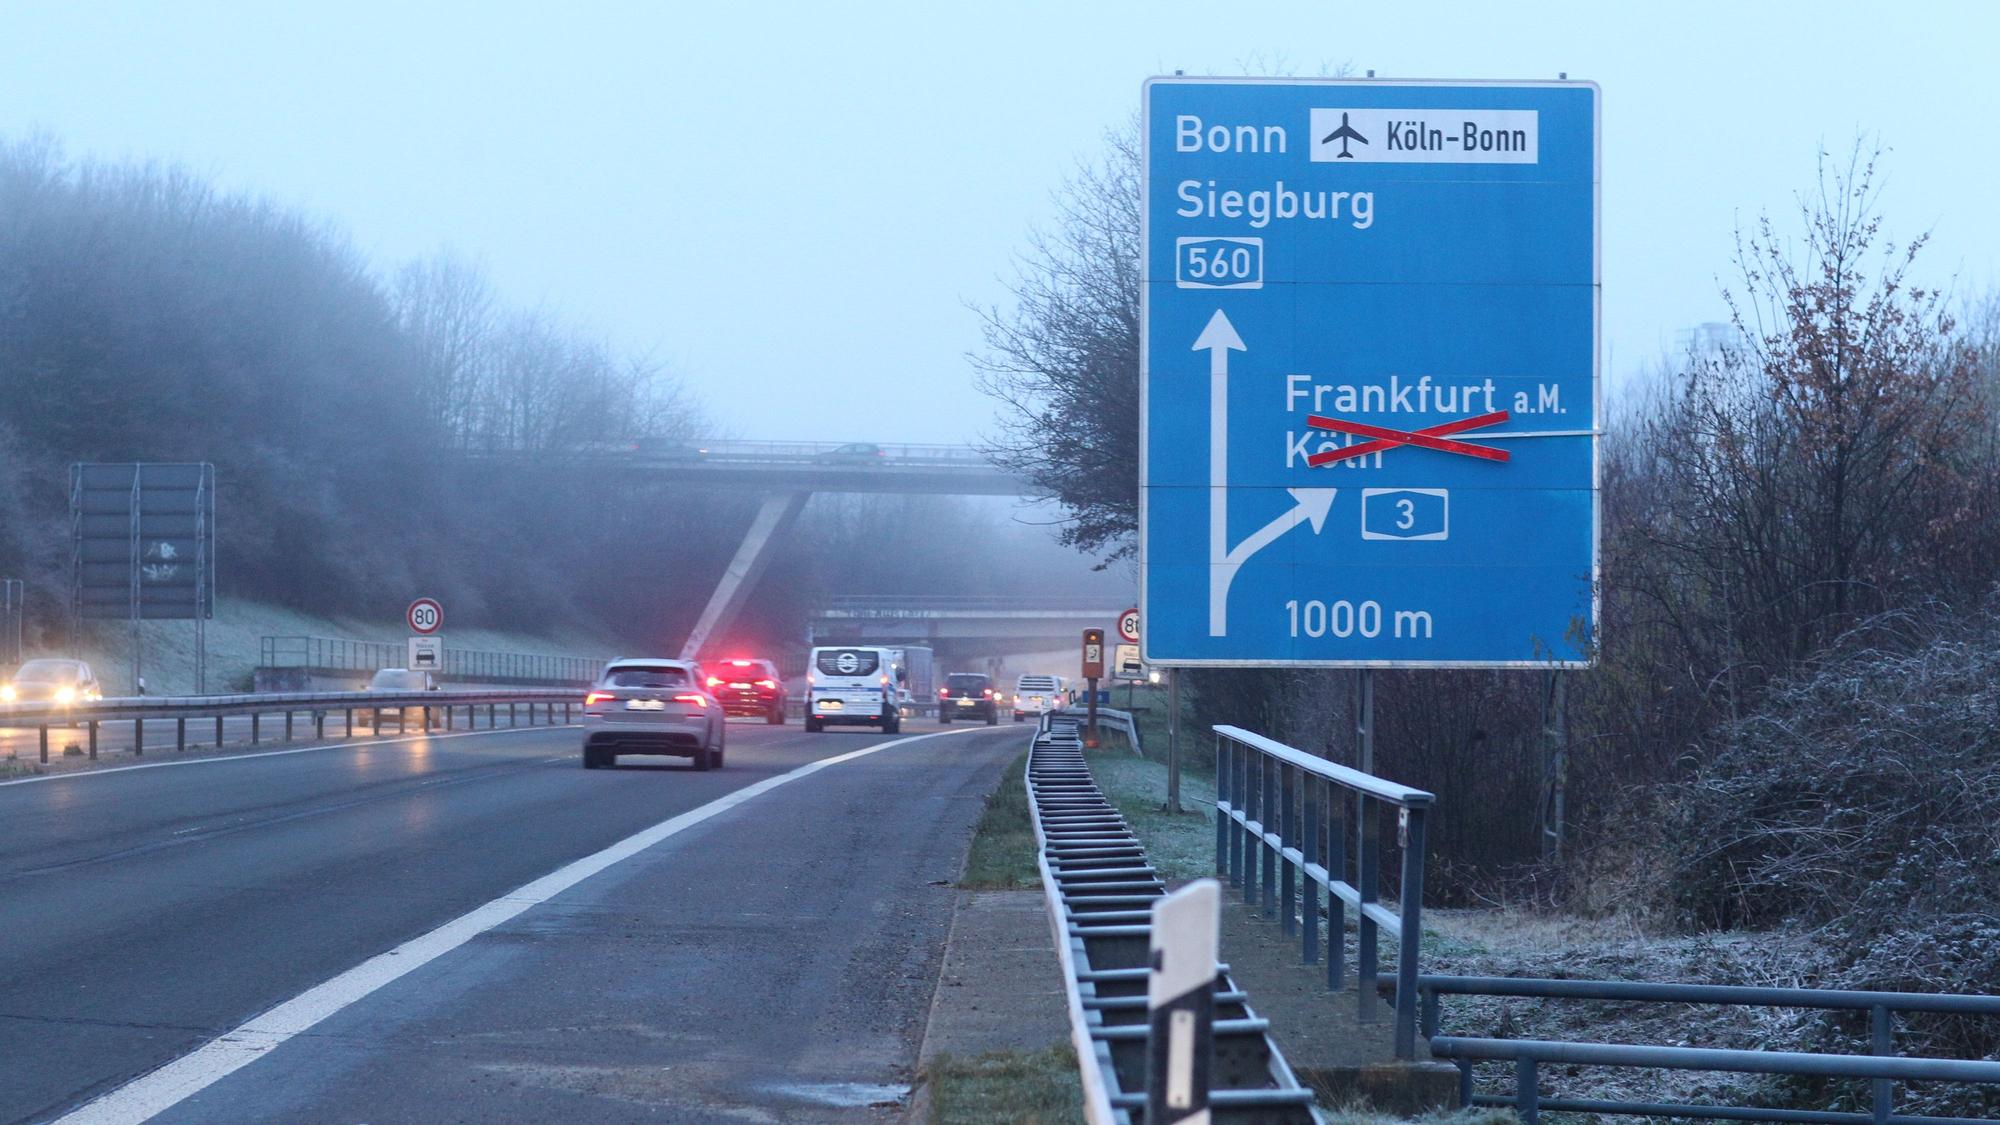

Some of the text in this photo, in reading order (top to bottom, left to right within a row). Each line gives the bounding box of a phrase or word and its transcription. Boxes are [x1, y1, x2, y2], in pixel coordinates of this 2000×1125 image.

[1176, 114, 1287, 153] Bonn
[1387, 120, 1526, 152] Köln-Bonn
[1176, 180, 1374, 229] Siegburg
[1188, 247, 1251, 279] 560
[1286, 374, 1566, 414] Frankfurt a.M.
[1395, 499, 1414, 529] 3
[415, 609, 435, 625] 80
[1286, 600, 1432, 638] 1000 m
